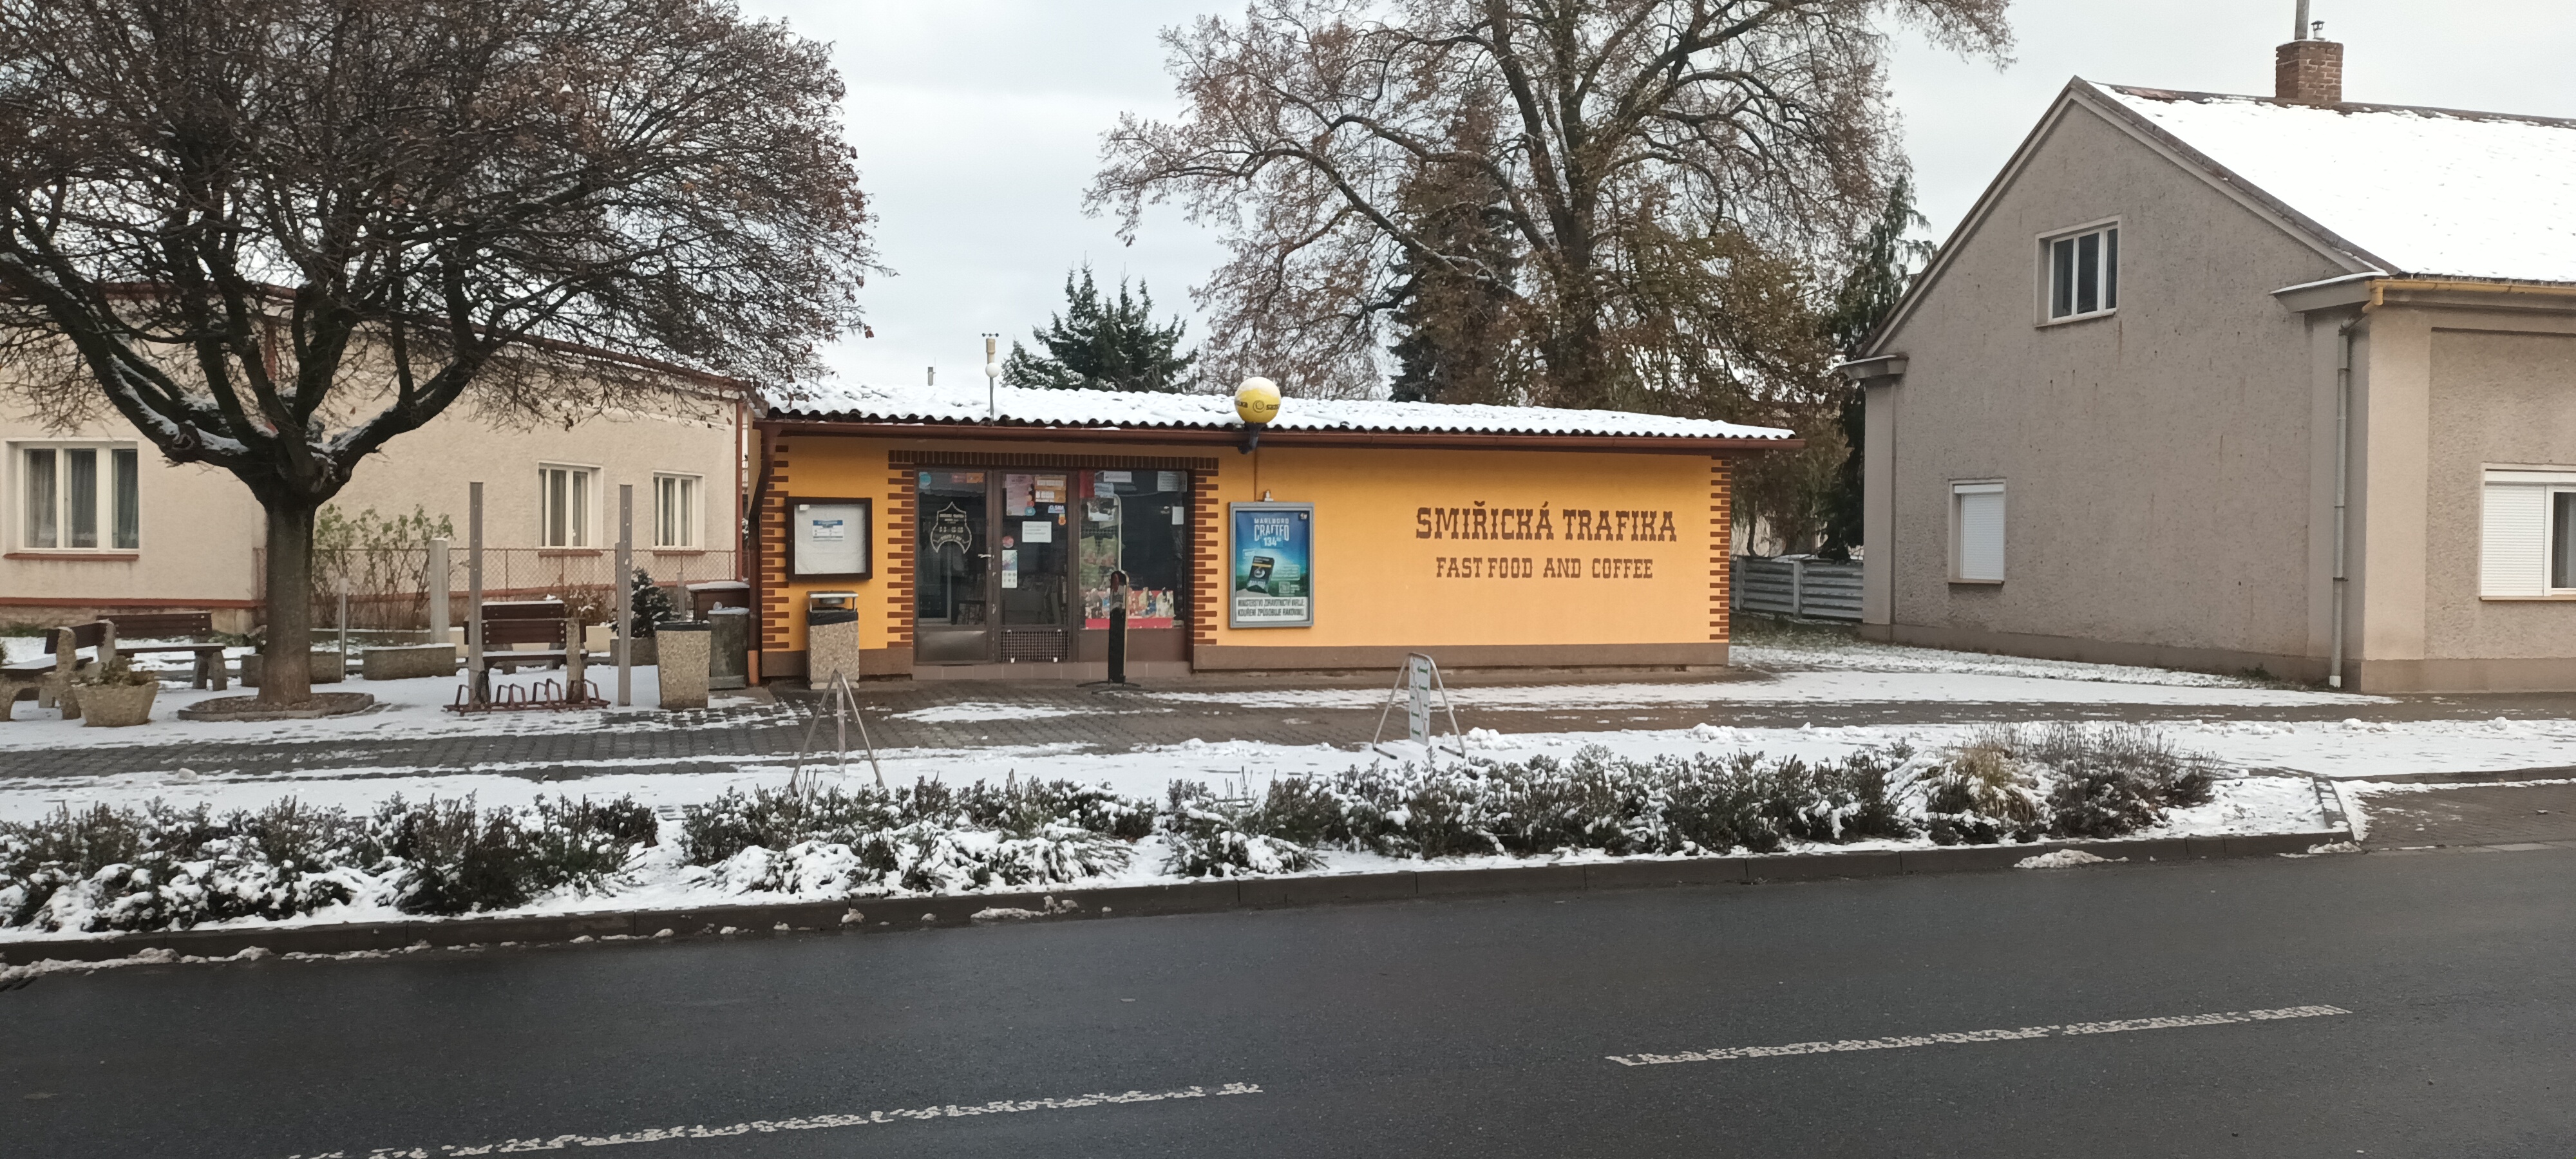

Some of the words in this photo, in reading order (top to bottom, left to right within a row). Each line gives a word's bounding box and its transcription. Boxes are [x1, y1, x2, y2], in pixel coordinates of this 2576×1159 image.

[1416, 500, 1555, 540] SMIŘICKÁ
[1562, 509, 1678, 542] TRAFIKA
[1436, 556, 1483, 578] FAST
[1488, 556, 1533, 579] FOOD
[1543, 558, 1582, 579] AND
[1591, 558, 1654, 579] COFFEE
